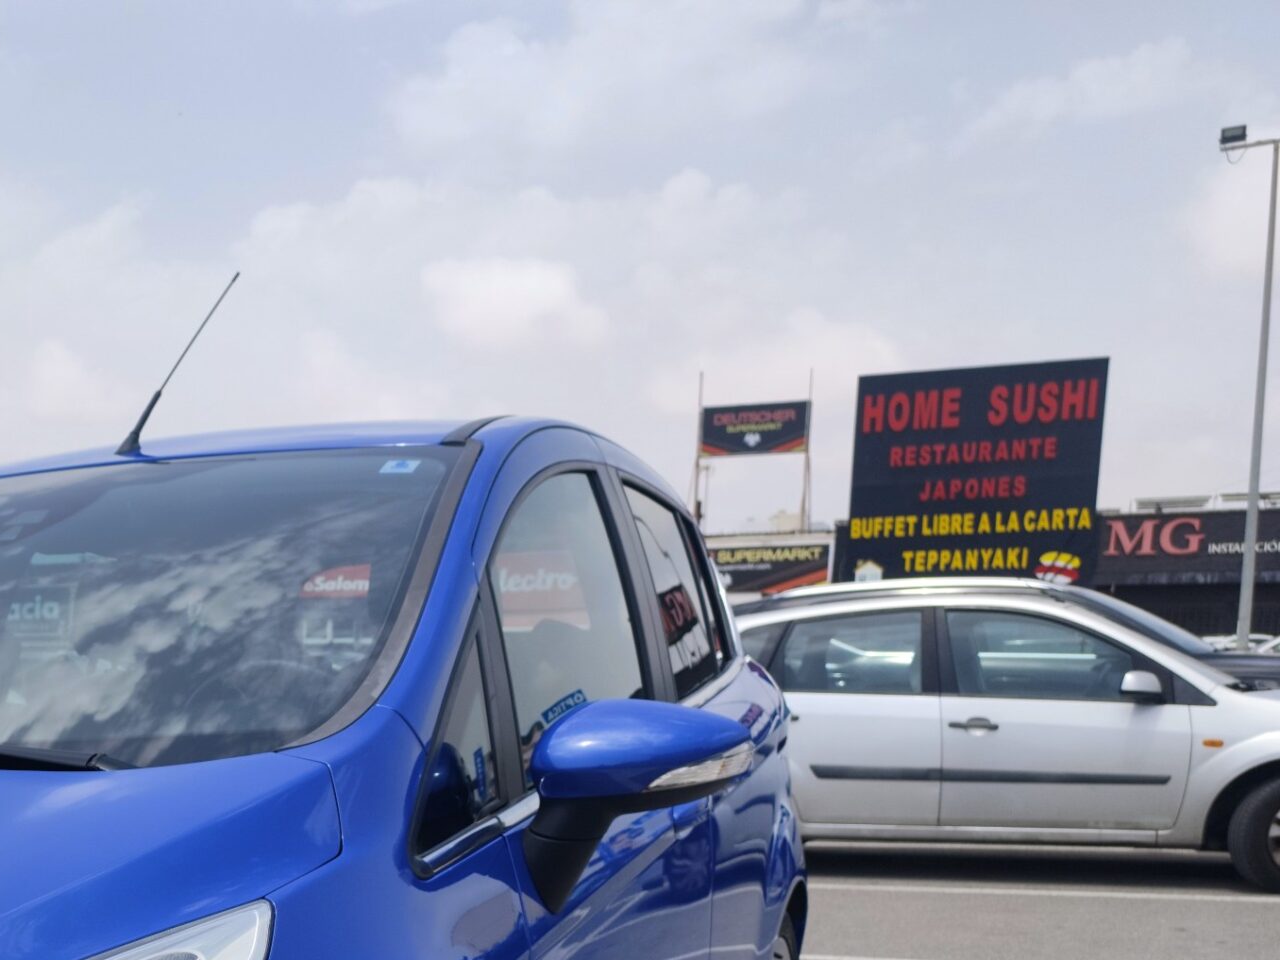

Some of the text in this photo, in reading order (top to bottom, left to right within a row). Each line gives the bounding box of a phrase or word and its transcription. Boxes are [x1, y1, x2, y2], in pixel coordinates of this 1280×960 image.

[862, 378, 1099, 434] HOME SUSHI
[889, 437, 1058, 467] RESTAURANTE
[919, 475, 1027, 502] JAPONES
[850, 507, 1092, 539] BUFFET LIBRE A LA CARTA
[1103, 517, 1206, 556] MG
[717, 547, 822, 563] SUPERMARKT
[902, 547, 1029, 572] TEPPANYAKI
